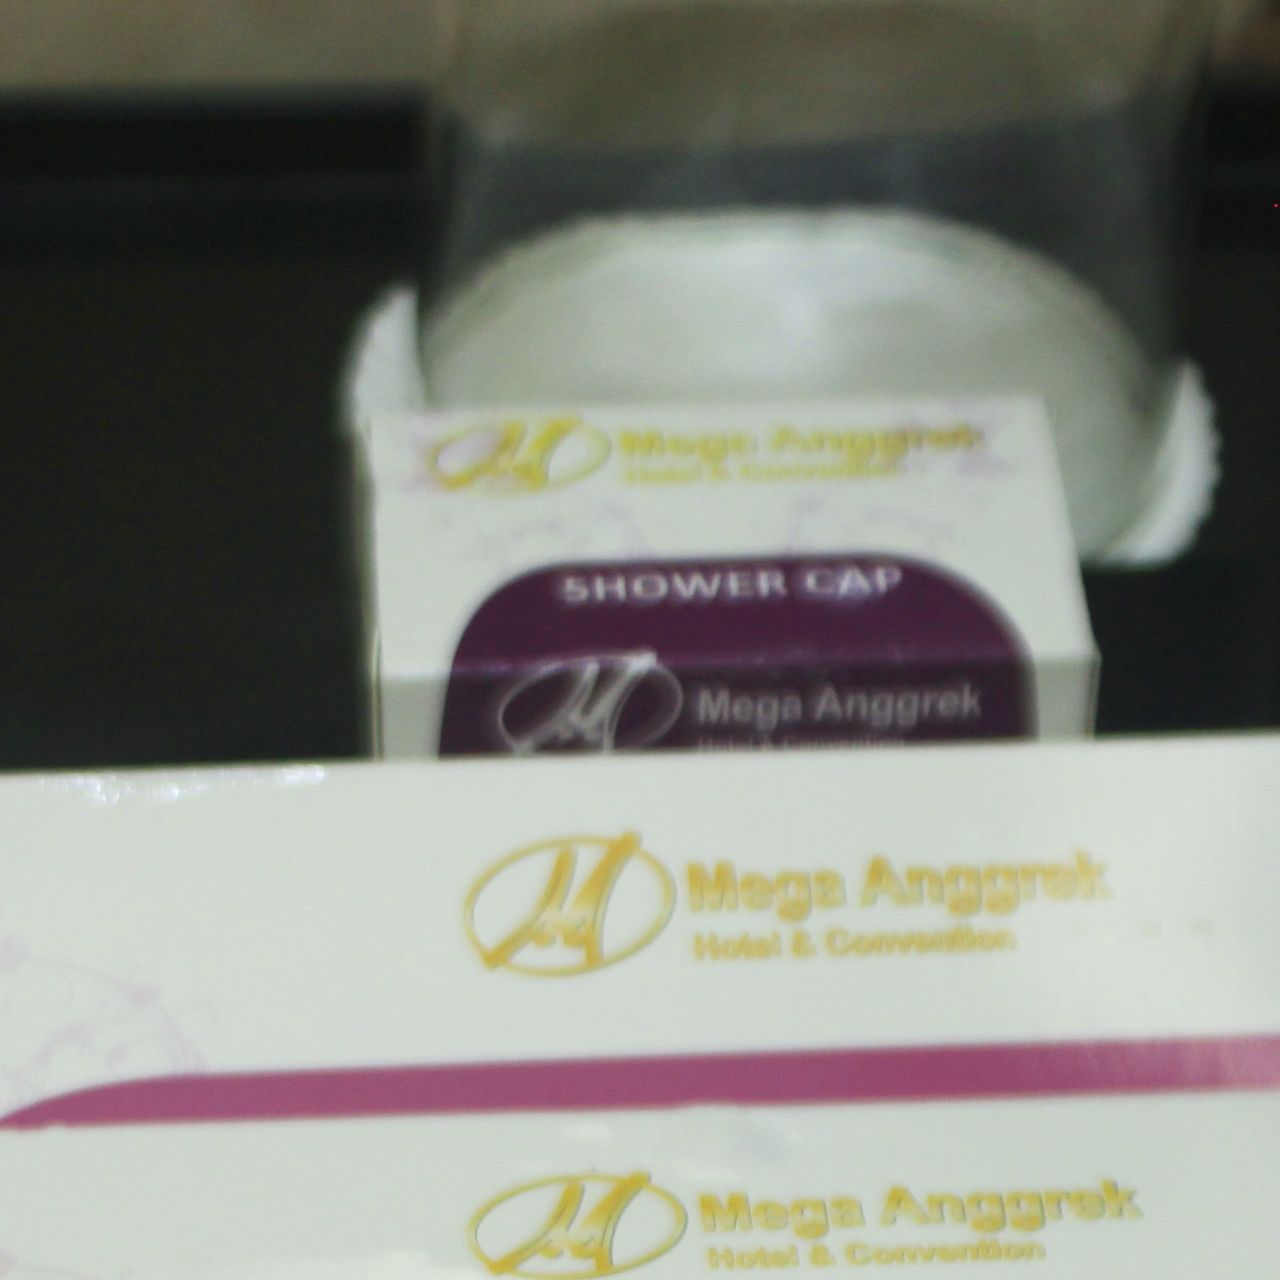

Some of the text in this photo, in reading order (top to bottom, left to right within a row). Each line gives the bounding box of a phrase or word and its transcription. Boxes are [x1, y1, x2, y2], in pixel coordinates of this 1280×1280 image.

[561, 566, 903, 603] SHOWER CAP
[697, 683, 982, 730] Mega Anggrek
[686, 850, 1112, 920] Mega Anggrek
[693, 925, 1016, 961] Hotel & Convention
[698, 1179, 1144, 1239] Mega Anggrek
[708, 1237, 1046, 1270] Hotel & Convention
